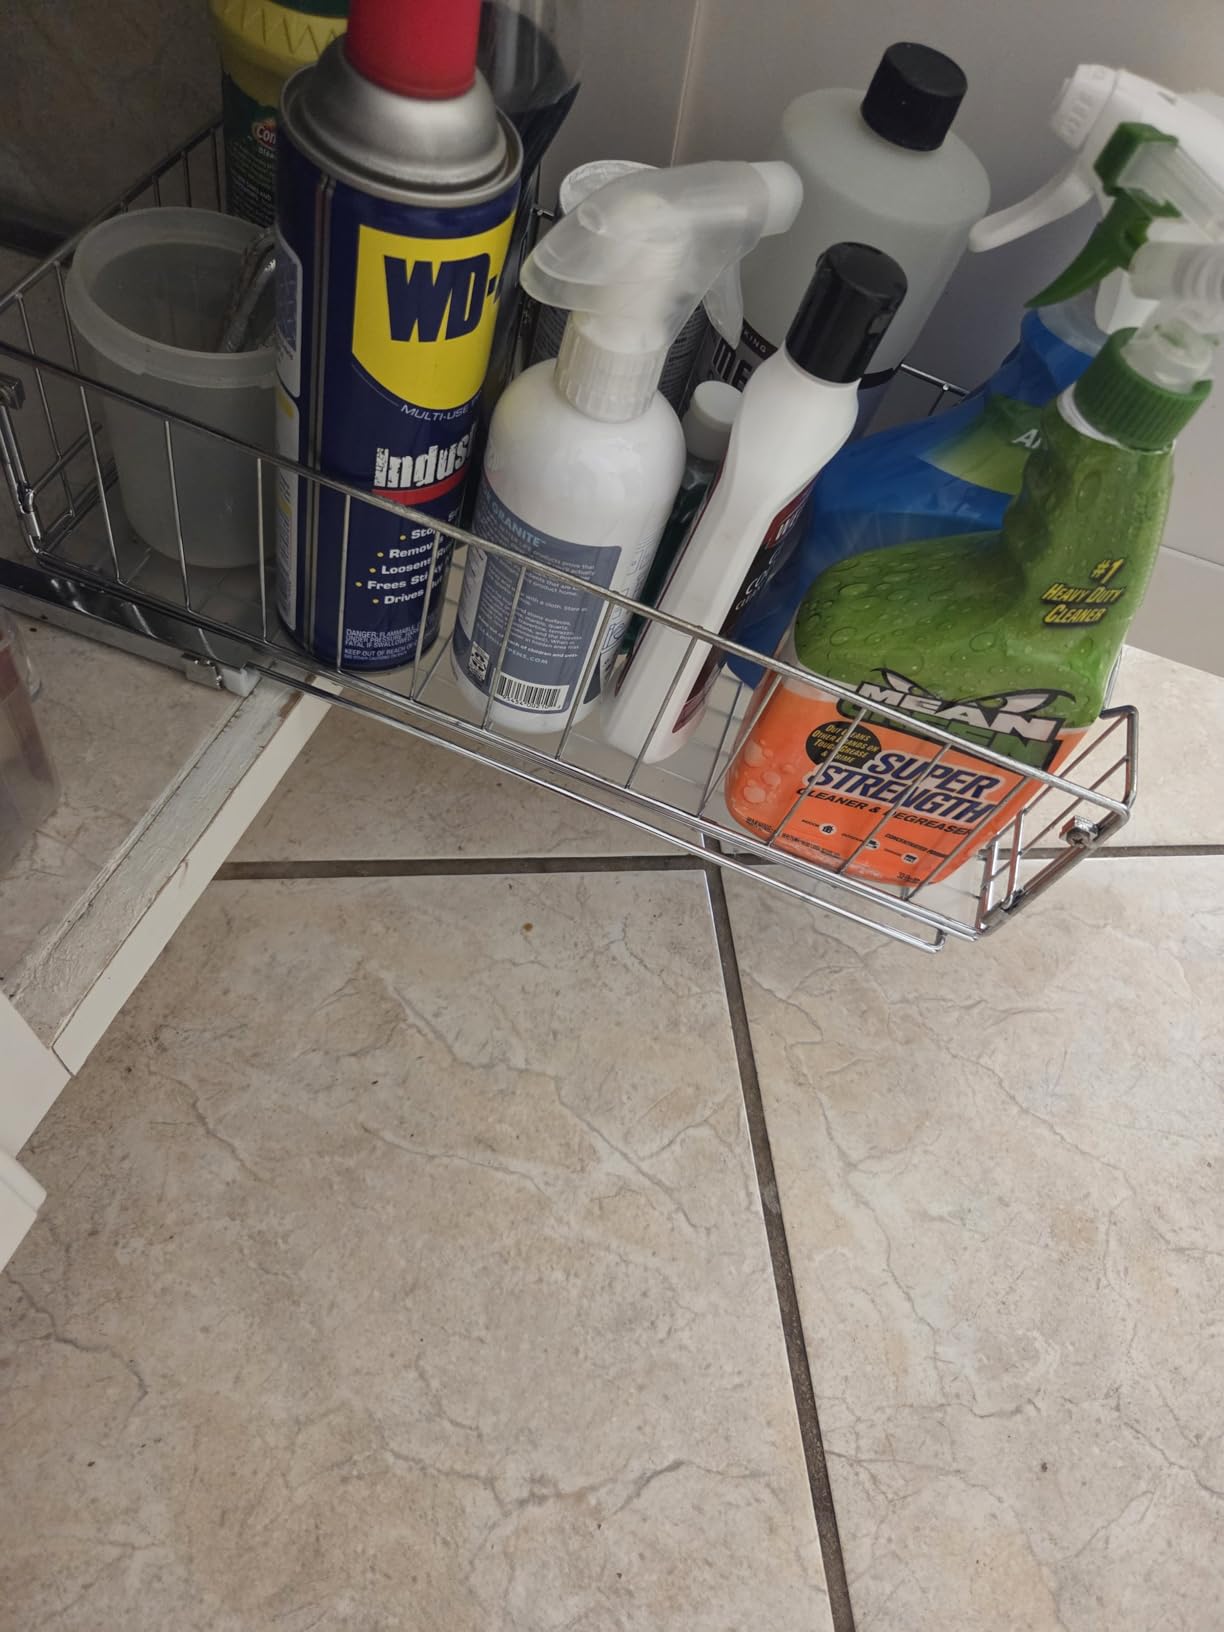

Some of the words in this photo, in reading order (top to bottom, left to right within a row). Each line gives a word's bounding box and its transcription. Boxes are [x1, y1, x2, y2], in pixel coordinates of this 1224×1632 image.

[384, 252, 500, 342] WD-
[401, 404, 469, 421] MULTI-USE
[411, 527, 436, 540] Sto
[1091, 559, 1125, 584] #1
[367, 580, 407, 590] Frees
[1041, 583, 1090, 602] HEAVY
[1086, 586, 1125, 603] DUTY
[384, 588, 425, 605] Drives
[1044, 603, 1107, 624] CLEANER
[857, 682, 1058, 742] MEAN
[814, 739, 838, 750] TOUG
[835, 736, 868, 749] BANDS
[841, 729, 871, 742] CEANS
[833, 753, 855, 763] RIME
[868, 753, 1000, 799] SUPER
[797, 788, 868, 811] CLEANER
[868, 806, 881, 814] &
[808, 765, 998, 824] STRENGTH
